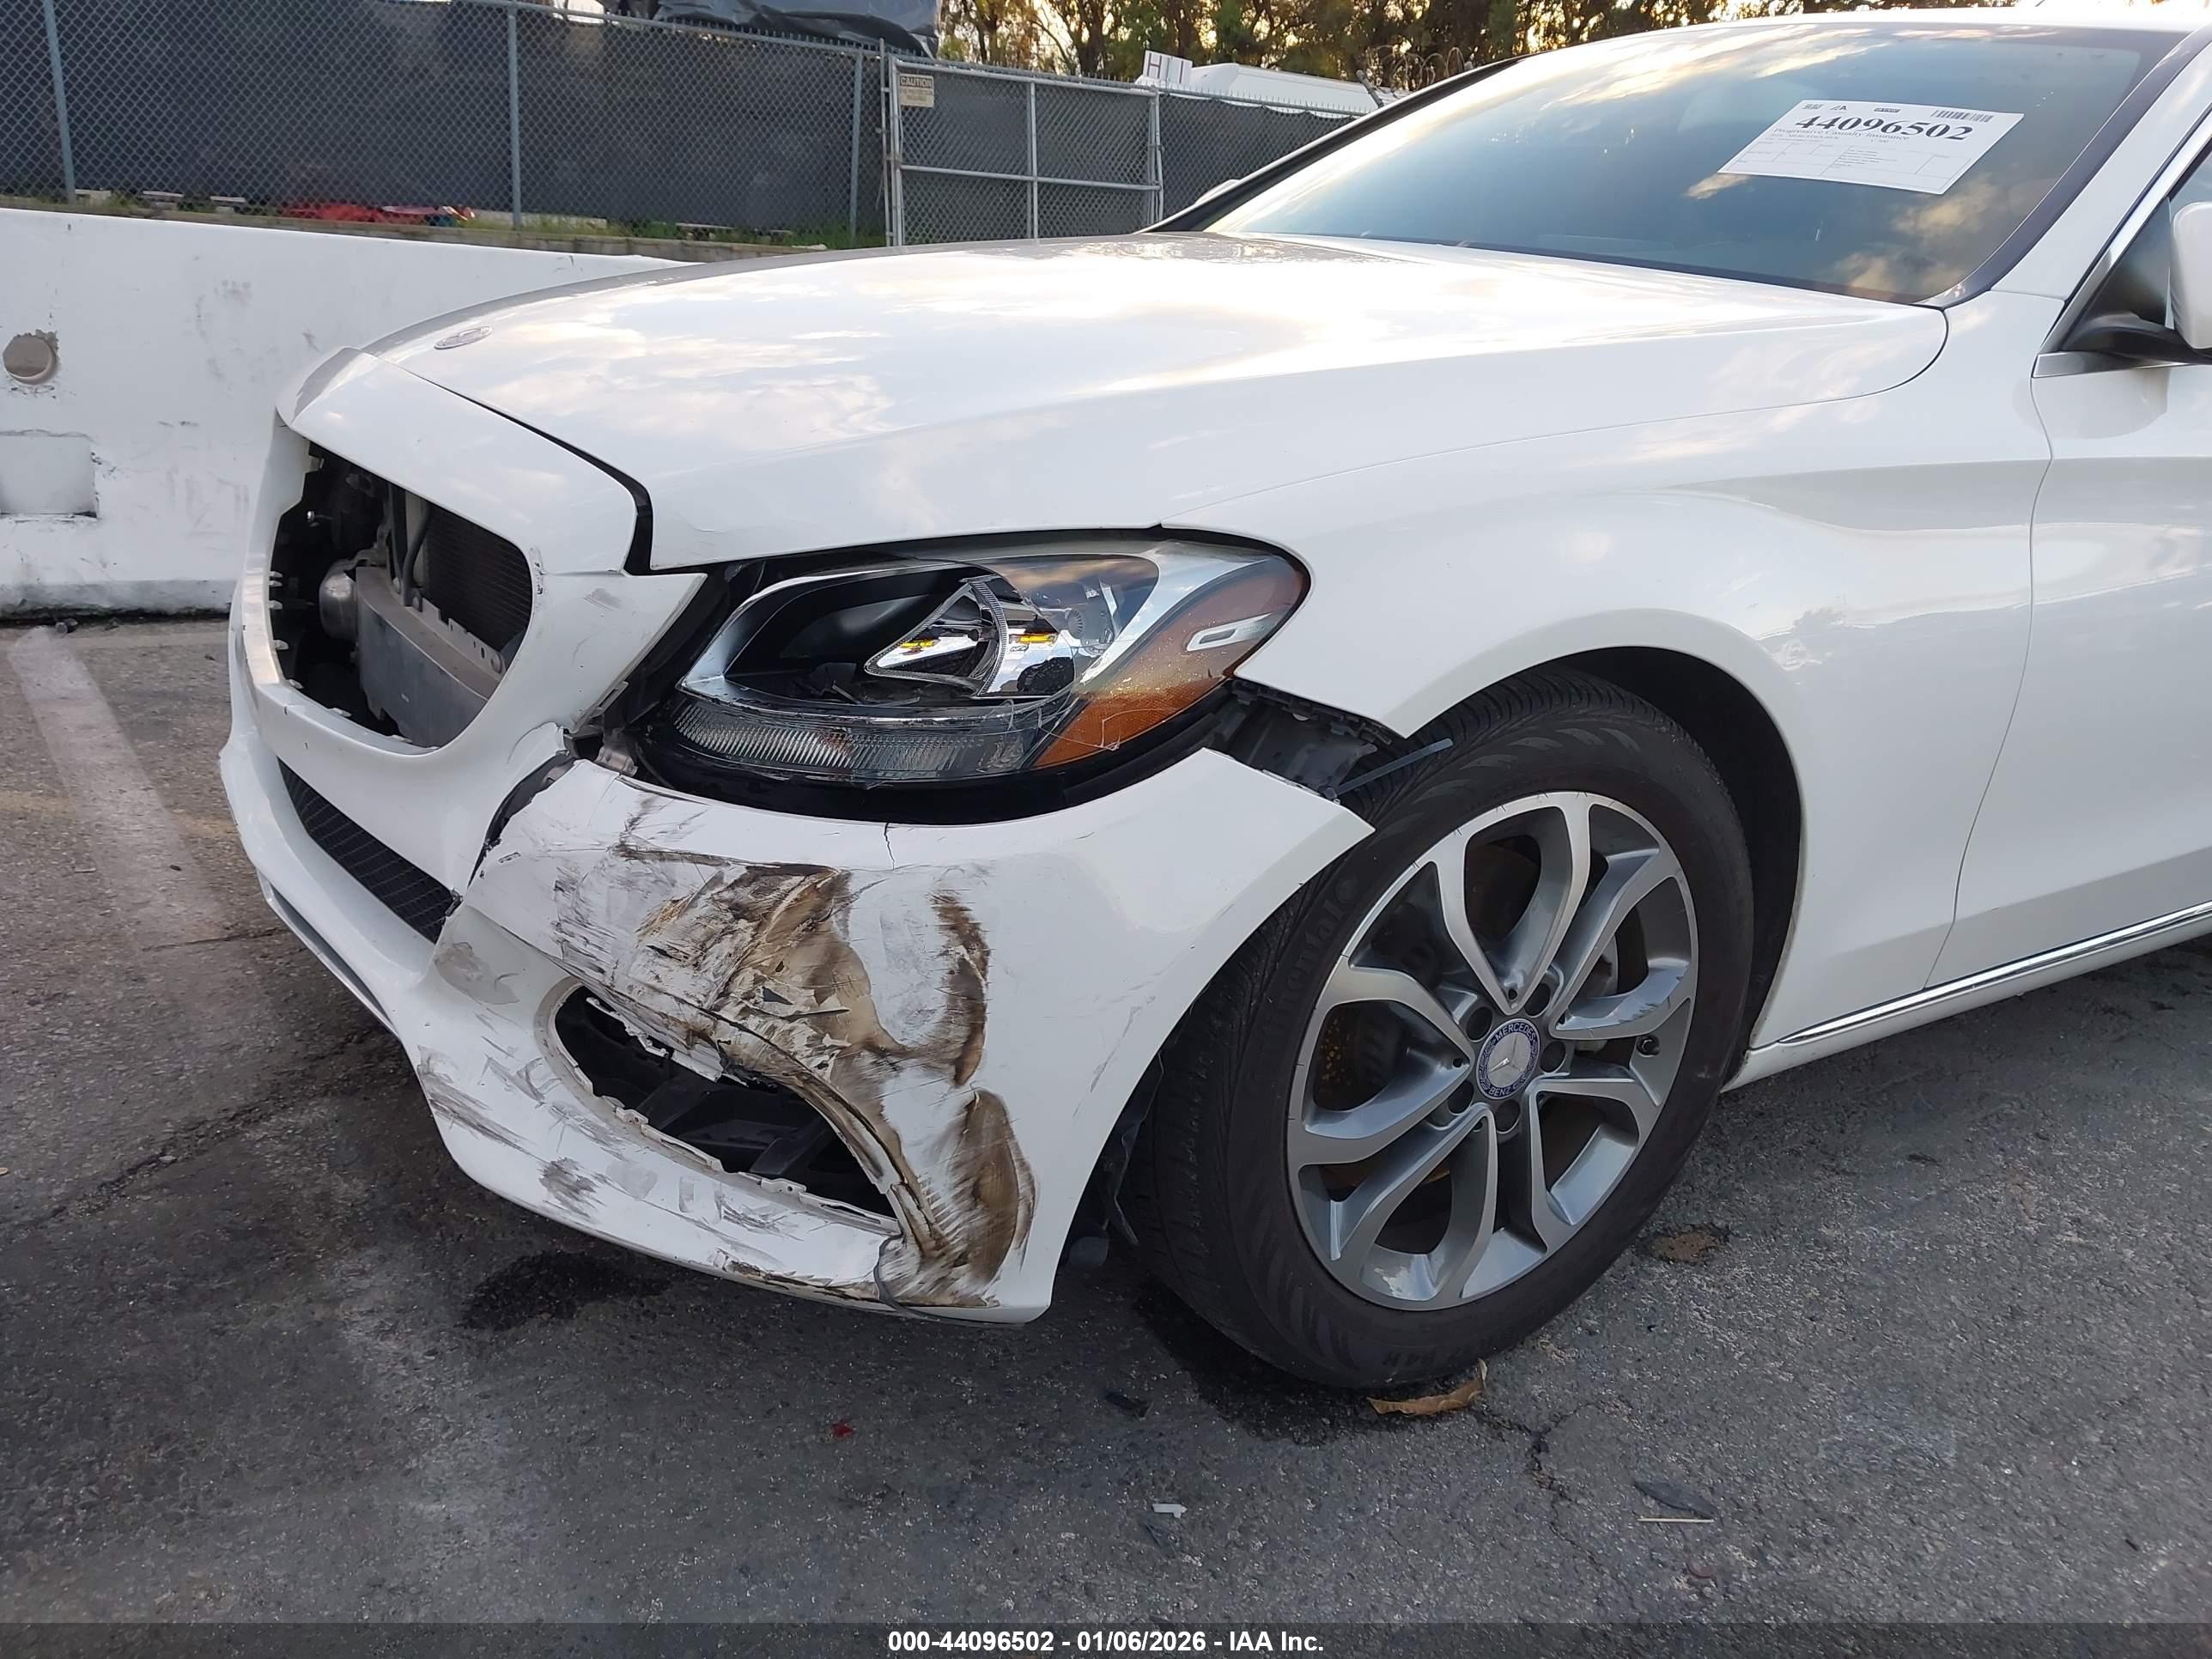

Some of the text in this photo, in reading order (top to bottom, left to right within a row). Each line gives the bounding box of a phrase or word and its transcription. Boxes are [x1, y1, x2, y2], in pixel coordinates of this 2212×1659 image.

[900, 76, 933, 88] CAUTION
[1796, 115, 1973, 140] 44096502
[1495, 1022, 1536, 1042] MERCEDES
[1488, 1085, 1512, 1097] BENZ
